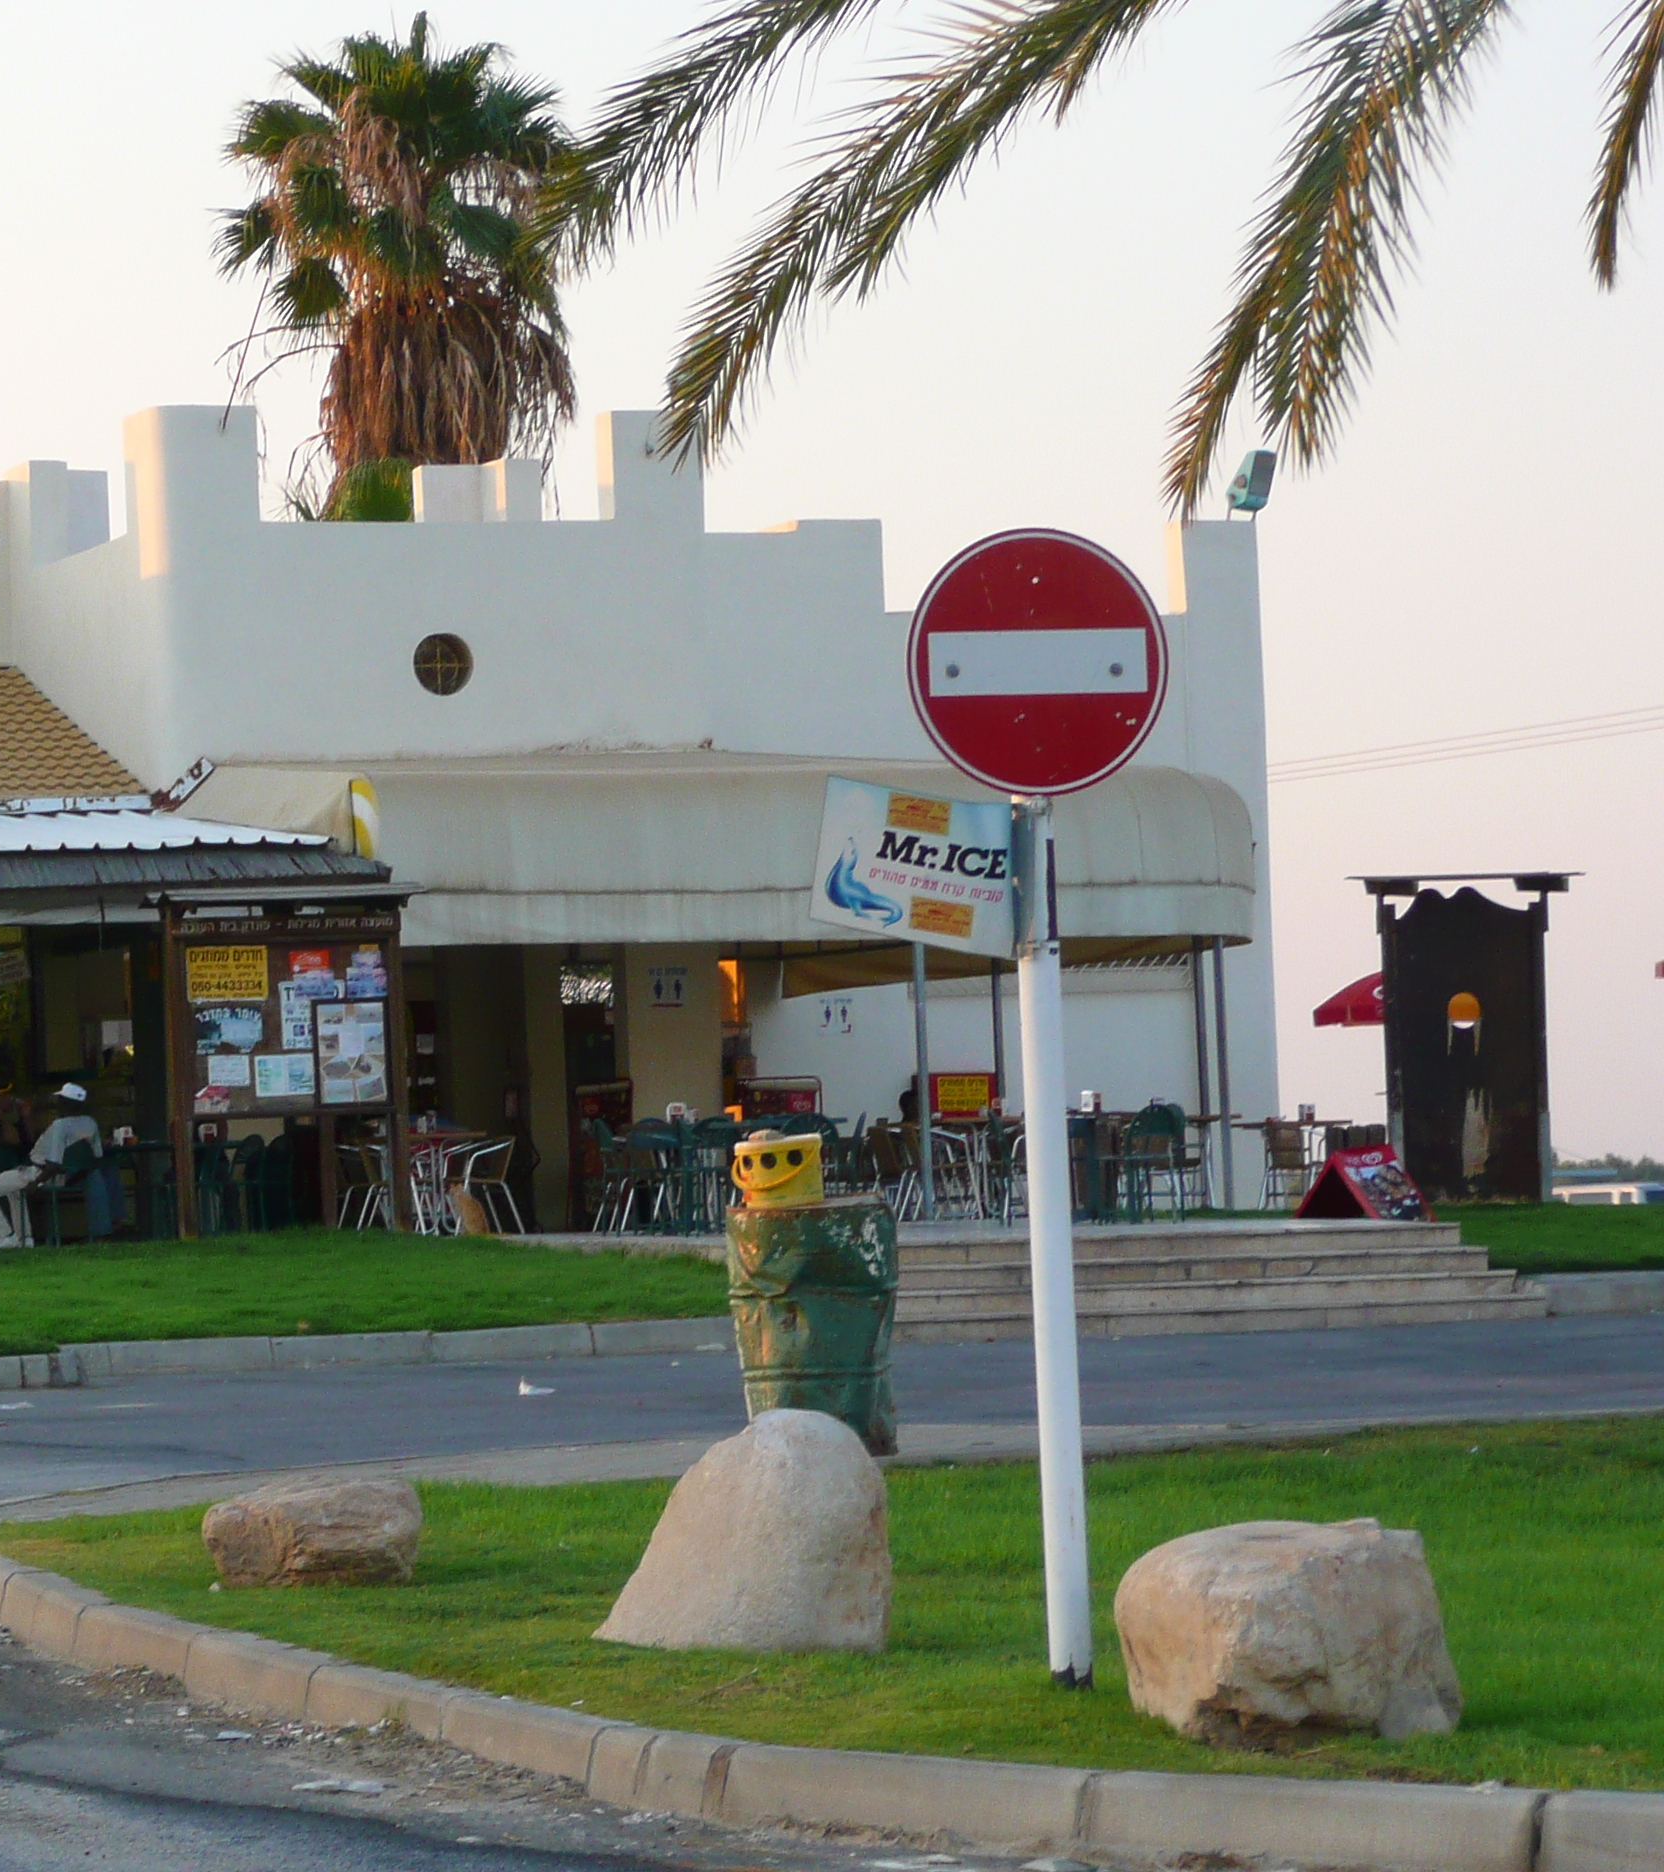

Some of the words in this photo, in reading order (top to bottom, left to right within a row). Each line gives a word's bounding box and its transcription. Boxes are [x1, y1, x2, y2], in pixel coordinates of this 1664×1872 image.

[941, 882, 966, 897] קרח
[189, 950, 229, 963] ממוזגים
[233, 950, 262, 961] חדרים
